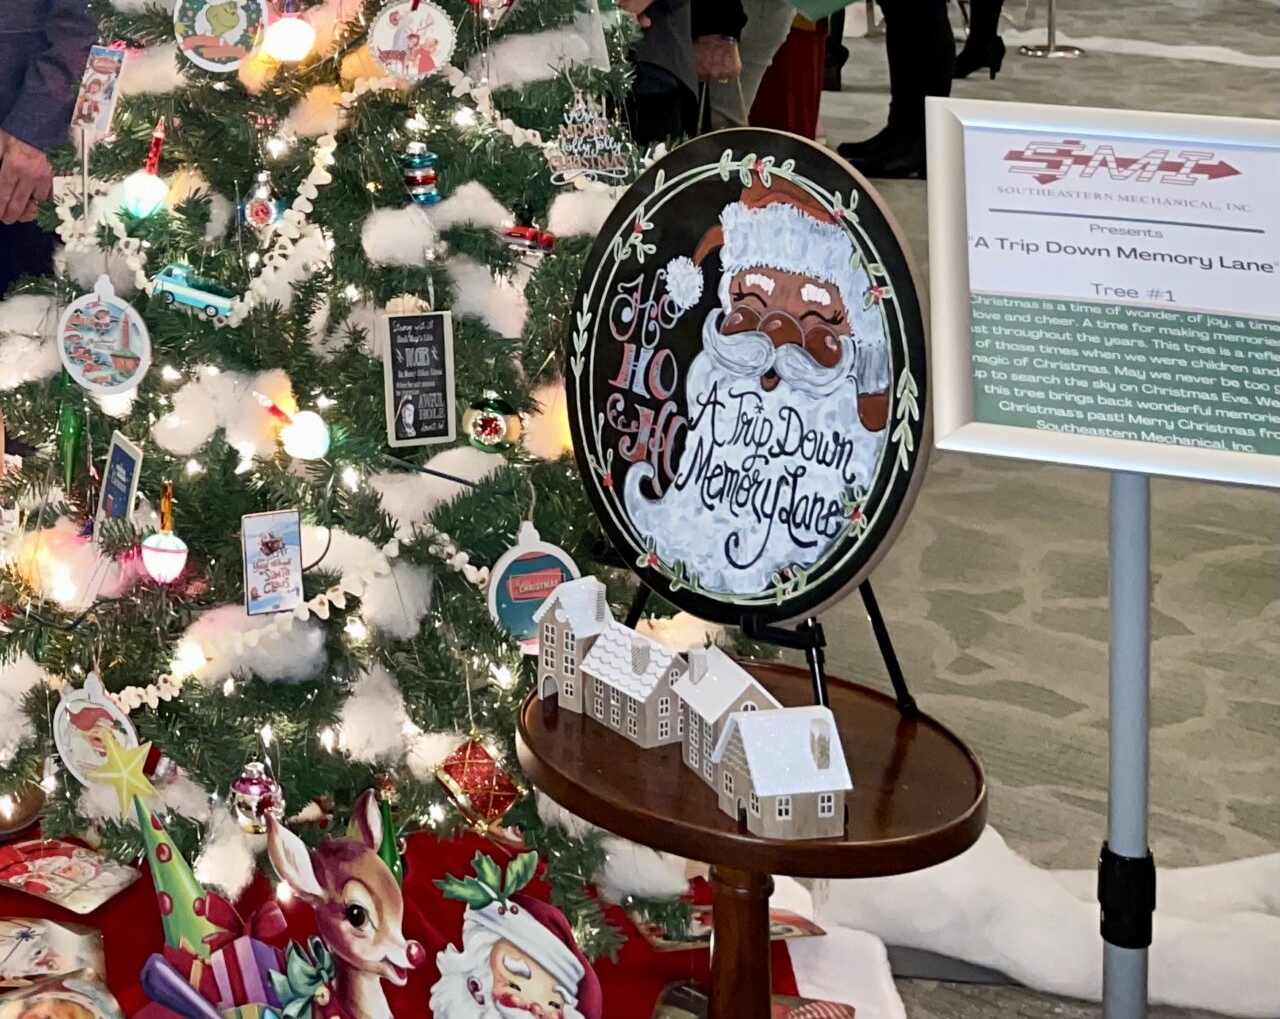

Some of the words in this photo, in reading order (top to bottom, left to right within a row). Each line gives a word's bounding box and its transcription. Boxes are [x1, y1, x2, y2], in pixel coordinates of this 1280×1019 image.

[1007, 140, 1215, 186] SMI
[997, 186, 1113, 200] SOUTHEASTERN
[1090, 223, 1164, 239] Presents
[995, 237, 1039, 255] Trip
[1046, 241, 1110, 258] Down
[1117, 246, 1212, 270] Memory
[1091, 282, 1139, 299] Tree
[1146, 288, 1176, 302] #1
[973, 309, 1001, 320] love
[1004, 314, 1031, 323] and
[1035, 315, 1079, 326] cheer.
[1082, 318, 1093, 327] A
[1097, 320, 1128, 331] time
[1132, 322, 1155, 333] for
[1159, 326, 1209, 341] making
[1043, 301, 1053, 310] is
[1071, 303, 1101, 314] time
[1105, 306, 1122, 315] of
[1187, 315, 1203, 323] of
[1236, 320, 1245, 328] a
[1249, 320, 1280, 331] time
[975, 339, 991, 348] of
[995, 341, 1035, 352] those
[1039, 345, 1079, 357] times
[1082, 349, 1120, 360] when
[1124, 354, 1146, 363] we
[1150, 356, 1187, 367] were
[1191, 359, 1248, 373] children
[1253, 367, 1280, 377] and
[992, 326, 1073, 341] throughout
[1076, 333, 1101, 343] the
[1104, 335, 1148, 347] years.
[1152, 339, 1180, 351] This
[1184, 343, 1216, 355] tree
[1221, 348, 1231, 356] is
[1235, 350, 1244, 358] a
[608, 342, 678, 400] HO
[991, 370, 1007, 380] to
[1011, 373, 1061, 385] search
[1064, 377, 1088, 388] the
[1093, 380, 1116, 393] sky
[1120, 384, 1138, 393] on
[1142, 384, 1218, 401] Christmas
[1013, 357, 1029, 367] of
[1114, 366, 1146, 380] May
[1150, 372, 1172, 381] we
[1176, 373, 1217, 385] never
[1221, 377, 1240, 388] be
[1244, 380, 1270, 391] too
[984, 384, 1010, 396] this
[1014, 388, 1045, 398] tree
[1049, 390, 1094, 405] brings
[1097, 394, 1133, 408] back
[1136, 401, 1212, 416] wonderful
[687, 380, 726, 447] A
[727, 386, 773, 472] Trip
[768, 405, 856, 484] Down
[1036, 419, 1138, 440] Southeastern
[1088, 411, 1125, 423] past!
[1128, 414, 1174, 430] Merry
[1177, 419, 1255, 437] Christmas
[674, 435, 789, 569] Memory
[778, 465, 842, 549] Lane
